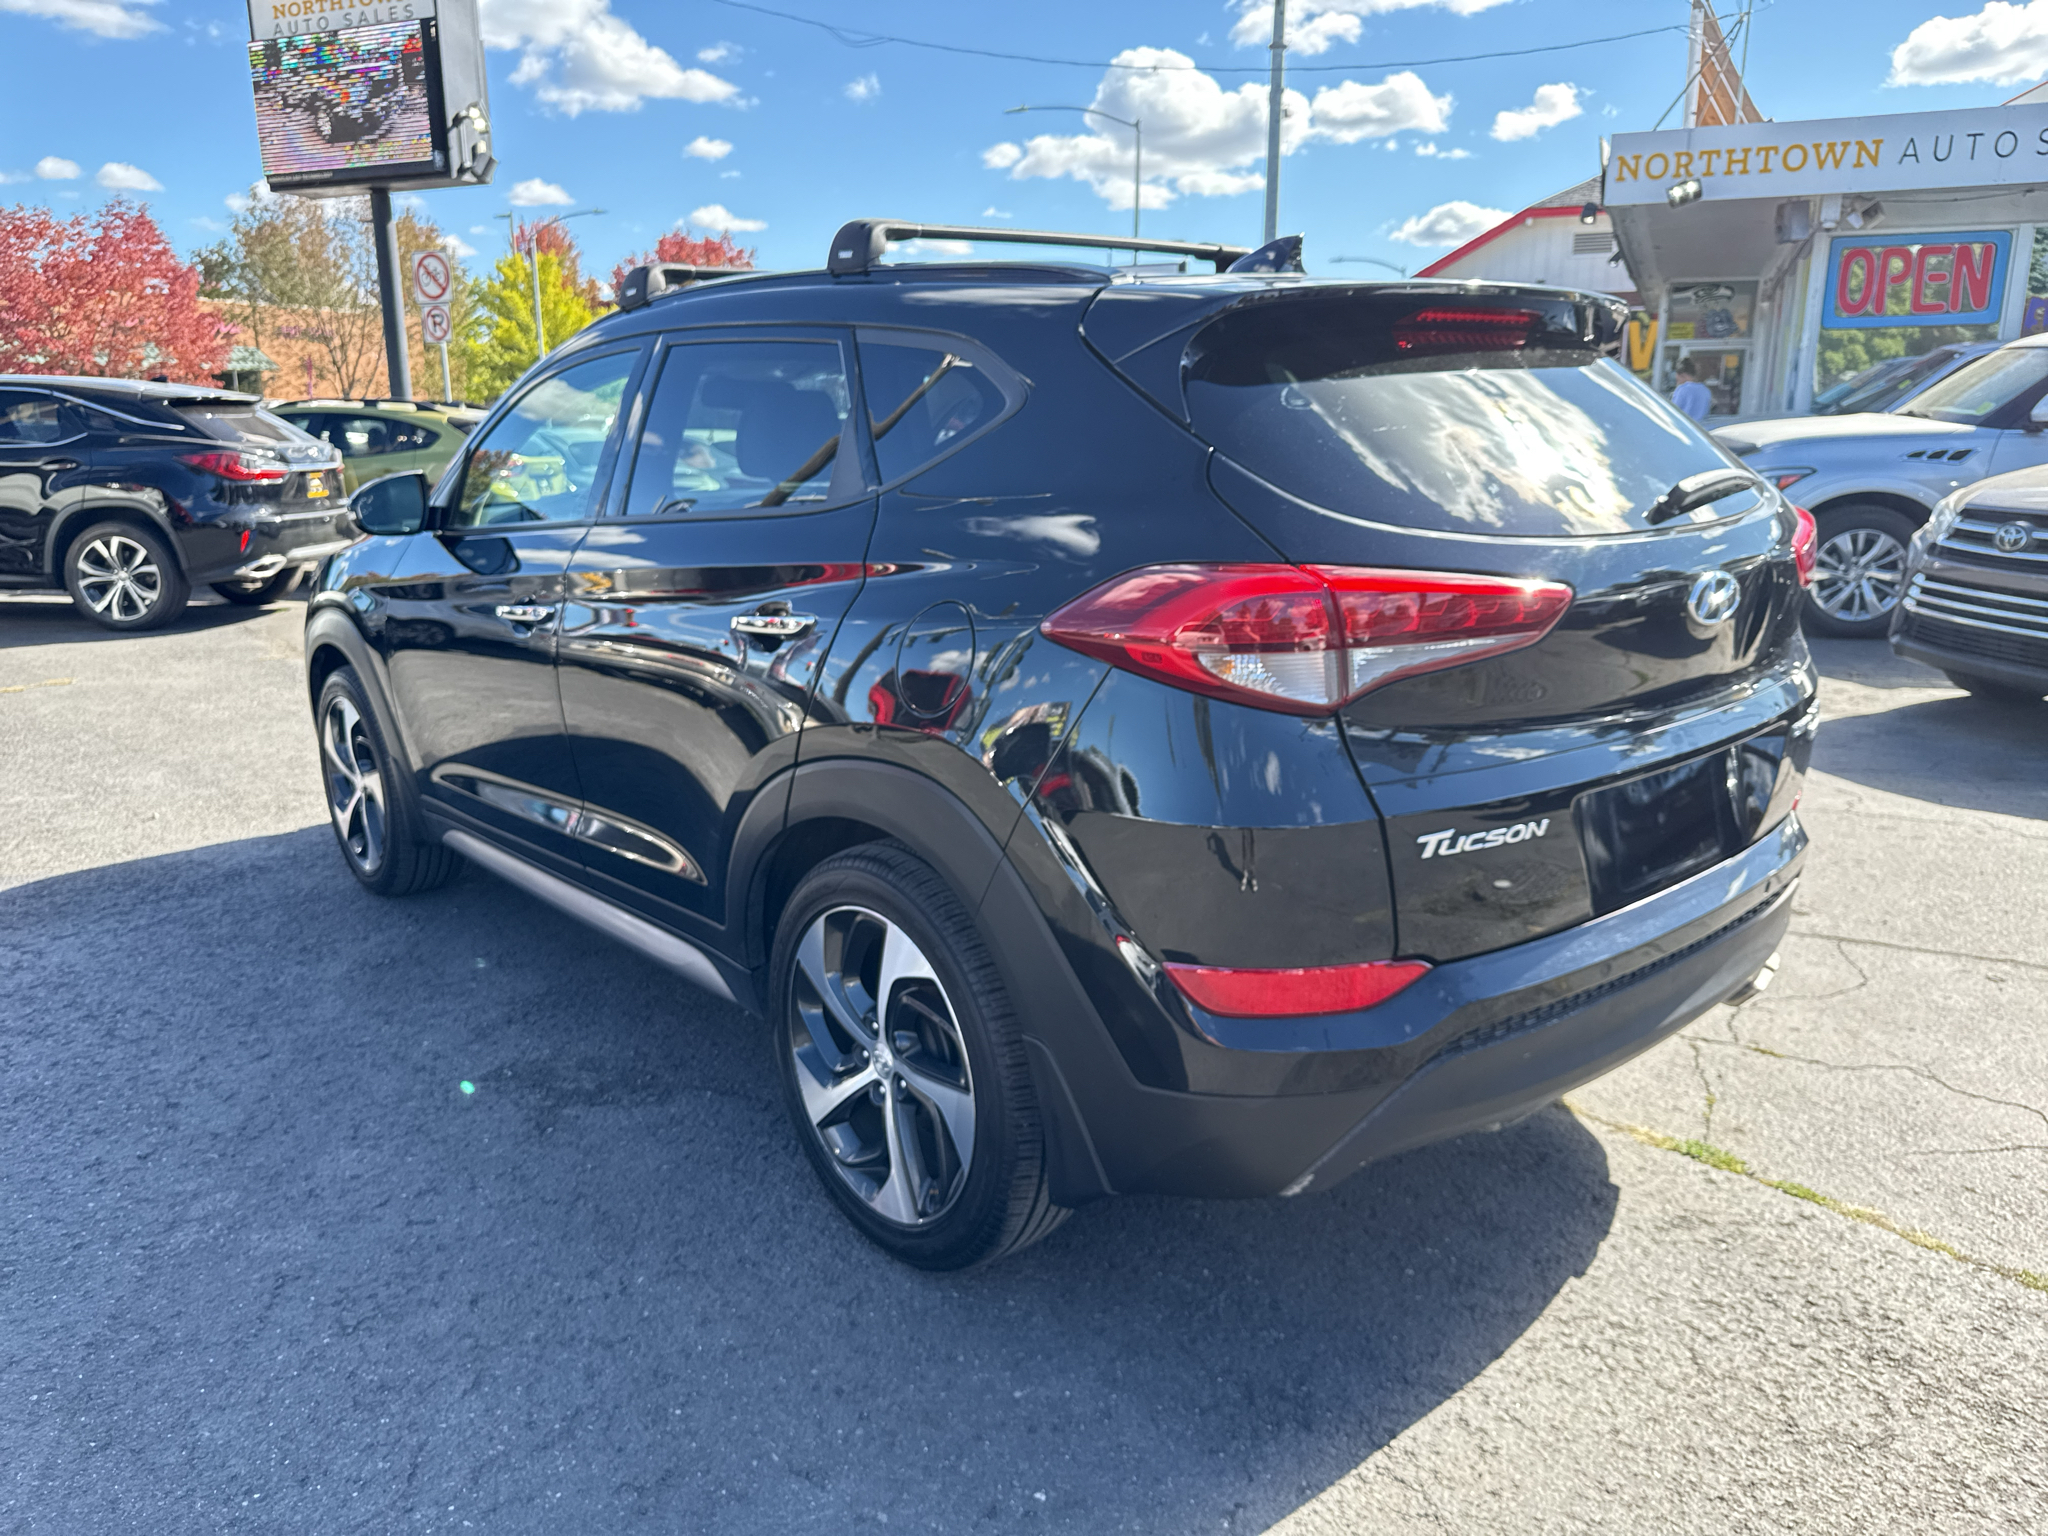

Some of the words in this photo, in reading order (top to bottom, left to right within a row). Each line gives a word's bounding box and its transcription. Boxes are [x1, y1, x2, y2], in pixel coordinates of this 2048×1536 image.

[273, 16, 330, 37] AUTO
[342, 3, 415, 27] SALES
[1616, 139, 1883, 182] NORTHTOWN
[1898, 131, 2018, 165] AUTO
[1837, 242, 1997, 317] OPEN
